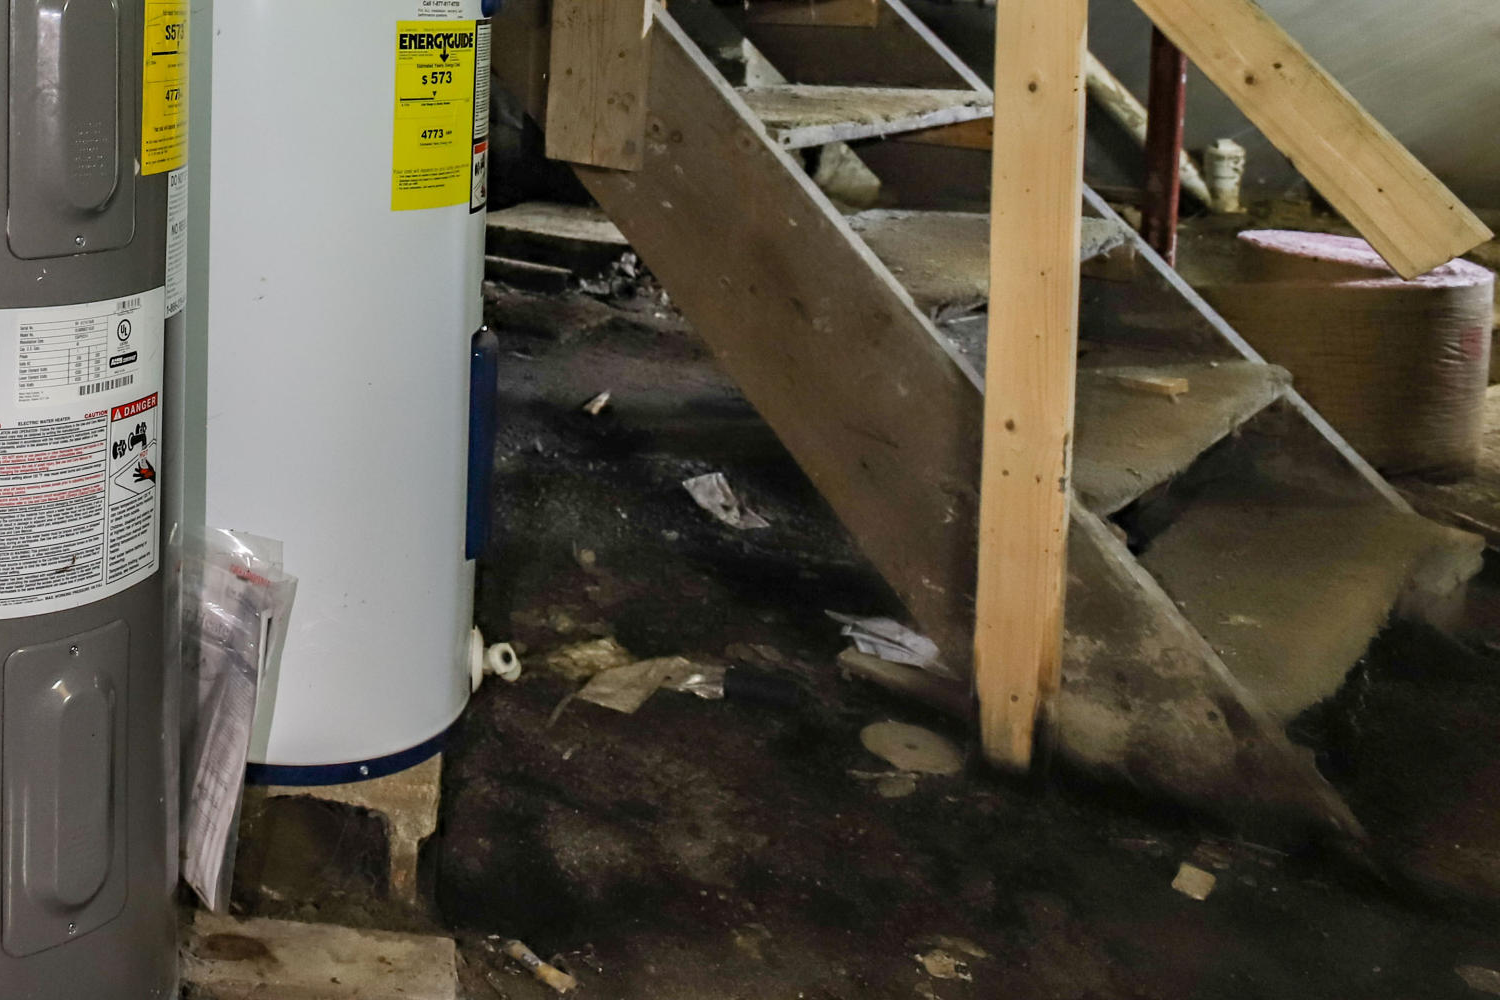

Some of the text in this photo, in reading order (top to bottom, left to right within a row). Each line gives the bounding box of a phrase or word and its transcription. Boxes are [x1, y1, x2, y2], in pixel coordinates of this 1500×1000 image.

[399, 33, 473, 49] ENERGYGUIDE
[431, 71, 452, 84] 573
[421, 129, 444, 139] 4773
[124, 397, 156, 416] DANGER
[84, 410, 108, 419] CAUTION
